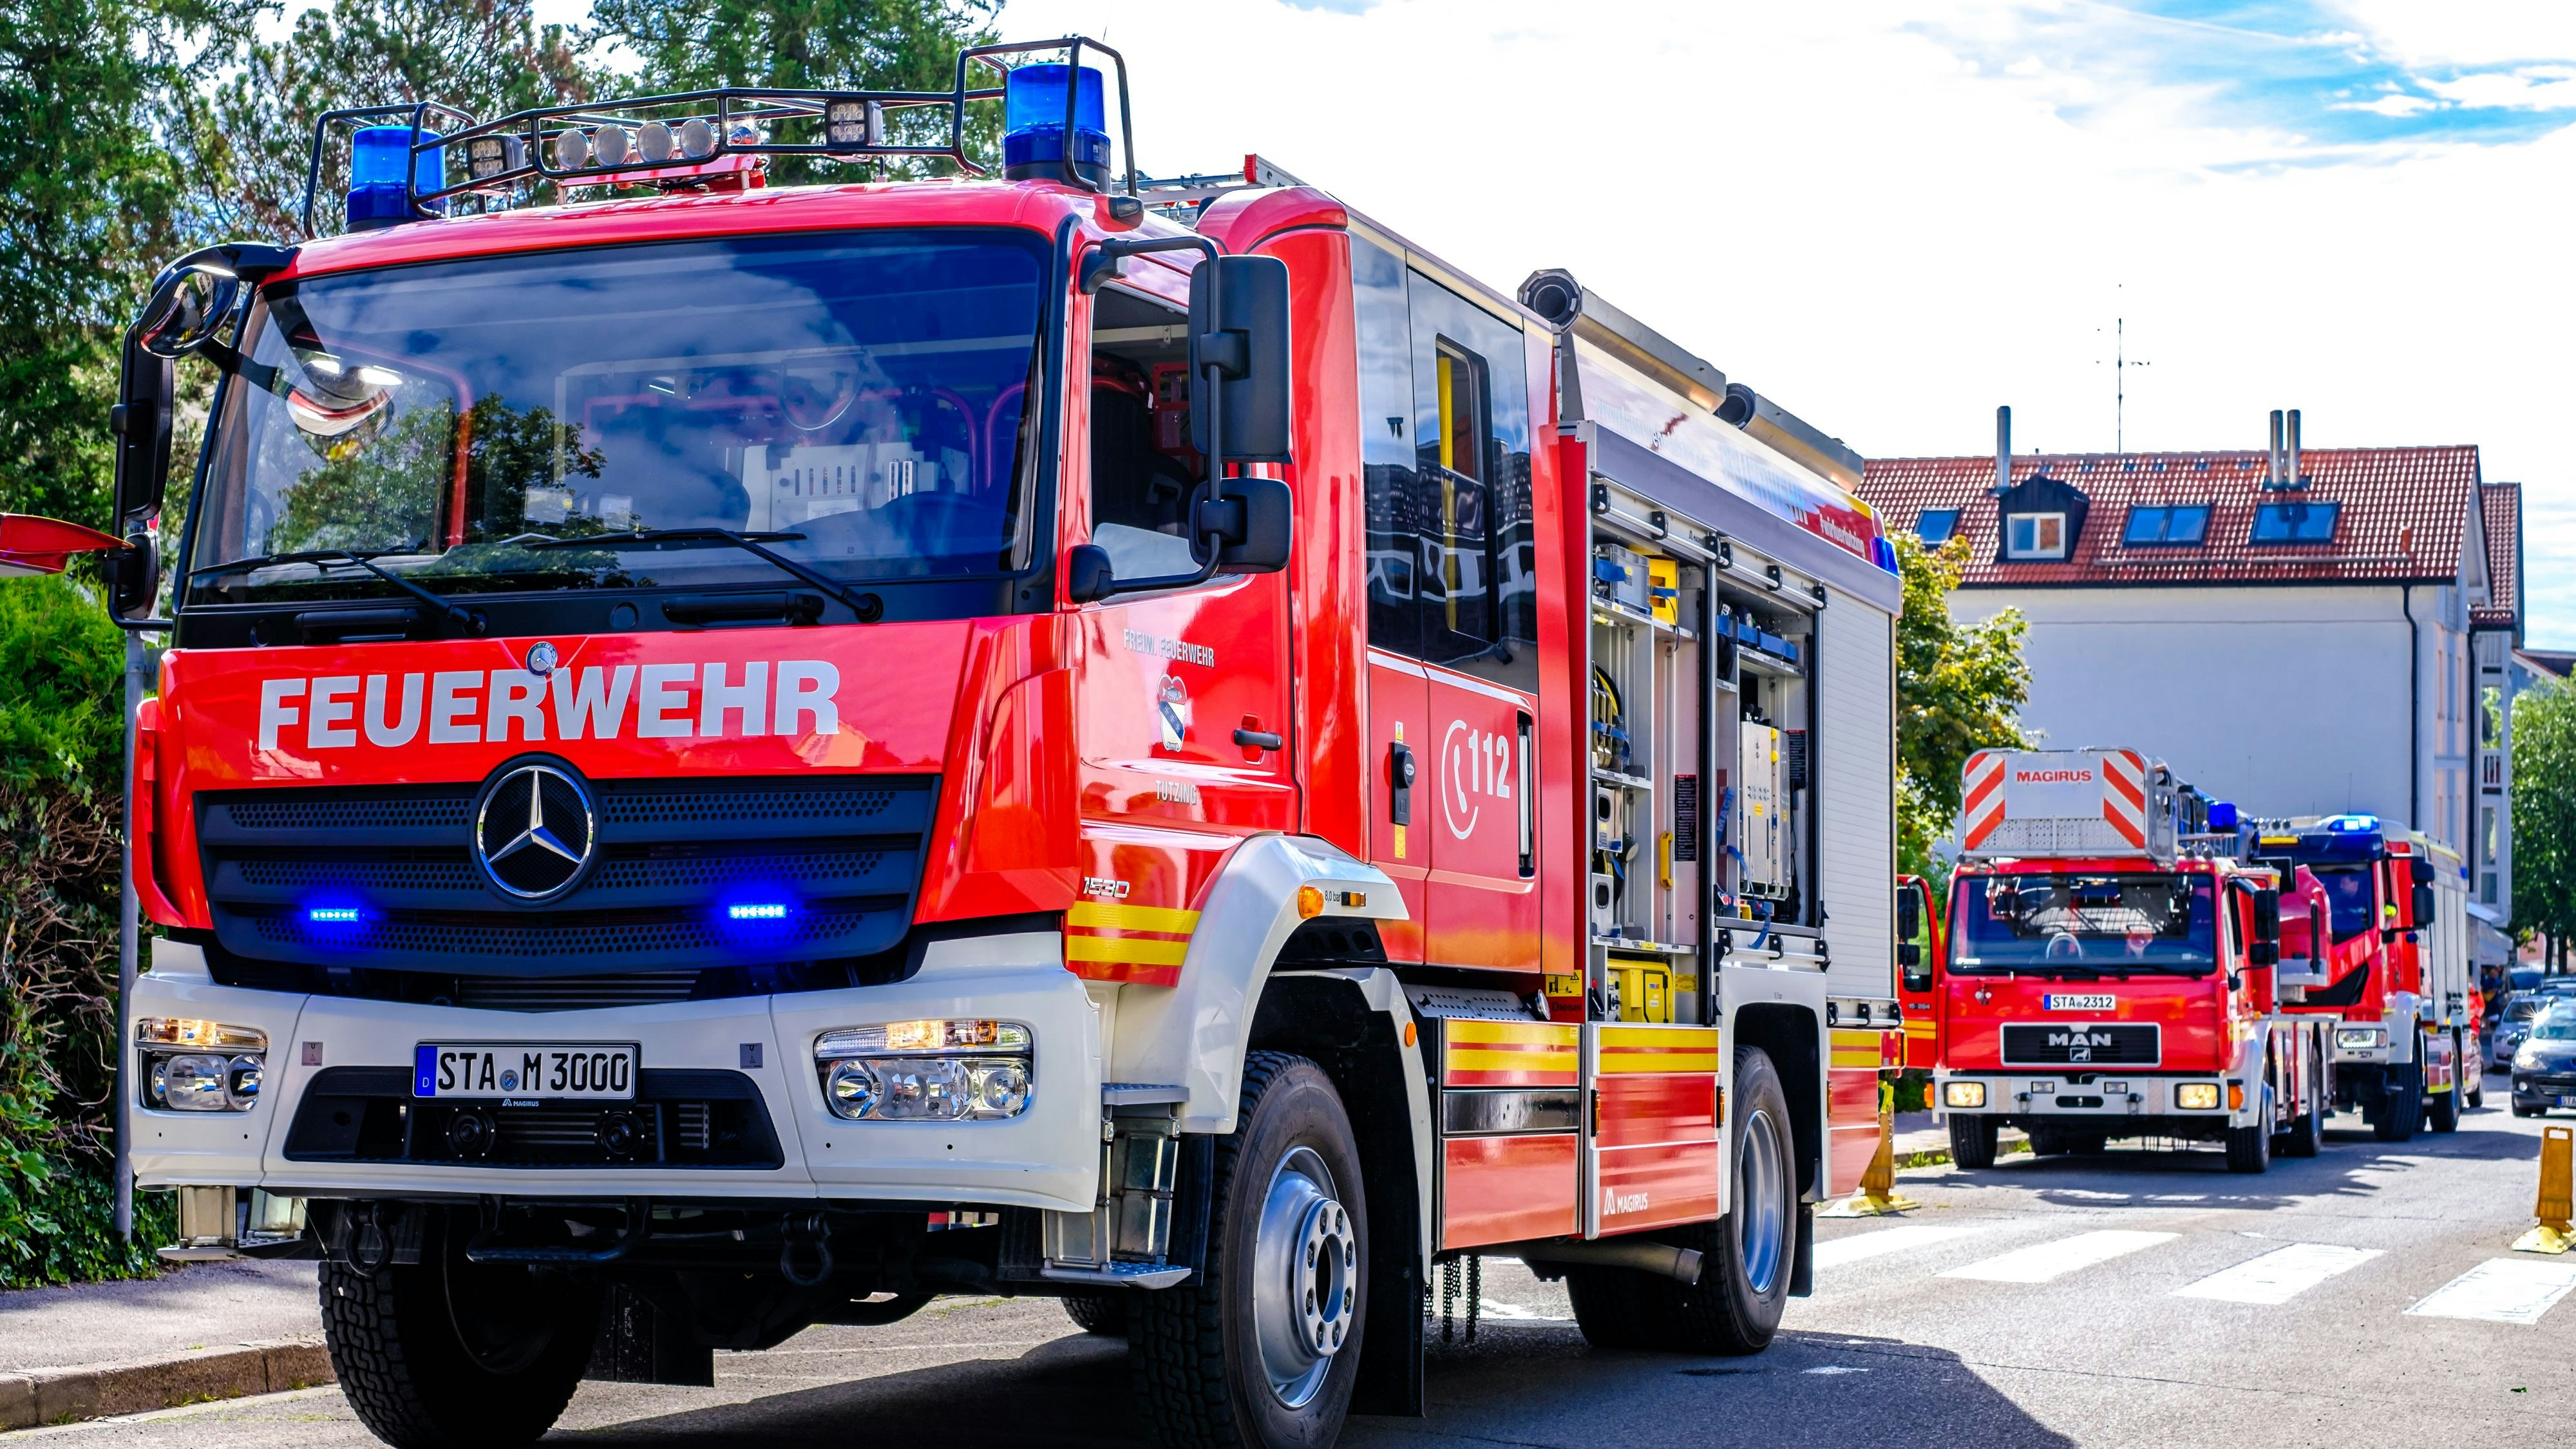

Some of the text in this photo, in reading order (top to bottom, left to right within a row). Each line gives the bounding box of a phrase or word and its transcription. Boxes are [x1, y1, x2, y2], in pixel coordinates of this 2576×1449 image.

[1123, 628, 1215, 668] FREIW. FEUERWEHR
[258, 659, 840, 752] FEUERWEHR
[1468, 728, 1510, 799] 112
[2016, 770, 2092, 782] MAGIRUS
[1155, 779, 1197, 806] TUTZING
[1083, 876, 1130, 898] 1530
[1552, 1002, 1582, 1012] Diesel
[2053, 996, 2112, 1008] STA 2312
[2049, 1033, 2112, 1046] MAN
[422, 1077, 430, 1088] D
[438, 1052, 629, 1092] STA M 3000
[1617, 1192, 1648, 1215] MAGIRUS
